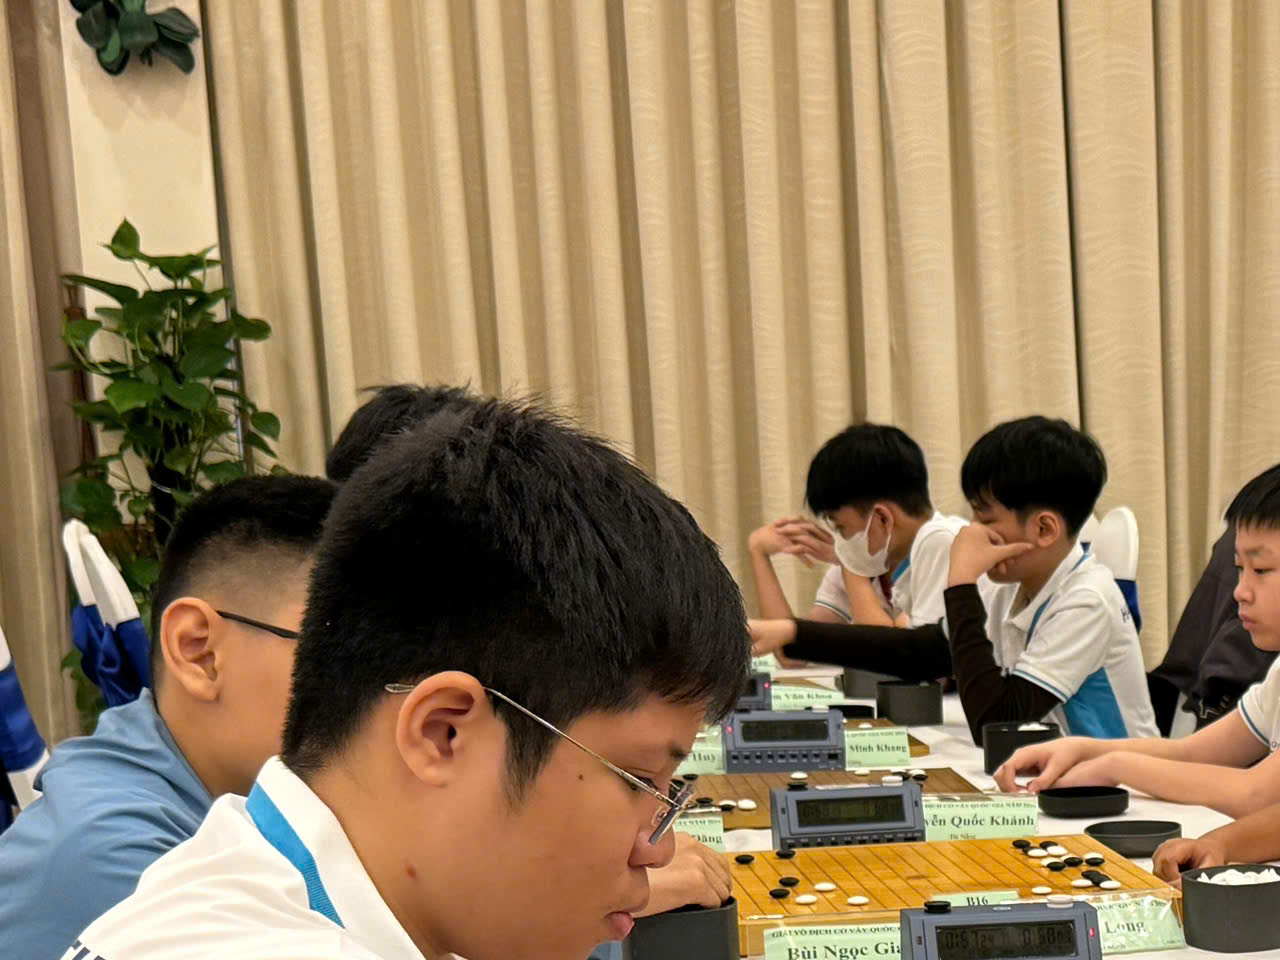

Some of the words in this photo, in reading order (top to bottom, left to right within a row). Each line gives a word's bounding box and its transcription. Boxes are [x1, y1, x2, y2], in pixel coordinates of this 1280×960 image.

[951, 814, 985, 828] Quốc
[990, 814, 1034, 826] Khánh
[966, 896, 988, 906] B16
[787, 946, 818, 960] Bùi
[824, 944, 868, 960] Ngọc
